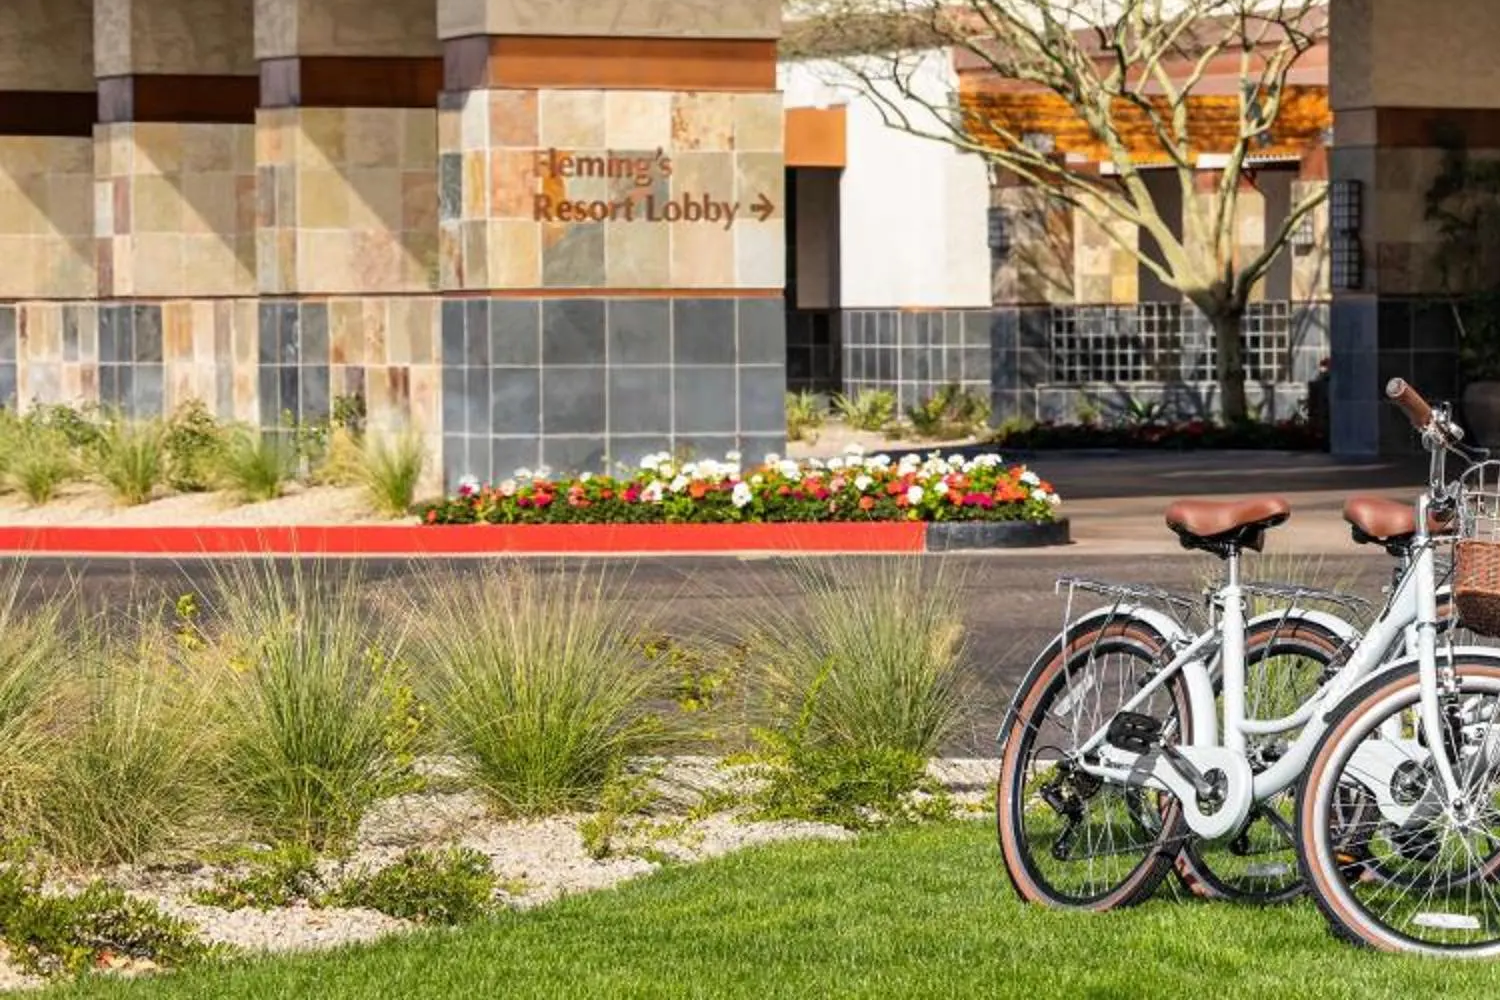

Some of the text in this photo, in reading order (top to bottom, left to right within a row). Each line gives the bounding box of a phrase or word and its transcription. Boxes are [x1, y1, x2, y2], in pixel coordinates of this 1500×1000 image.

[533, 147, 673, 187] Fleming's
[533, 191, 740, 231] Resort Lobby
